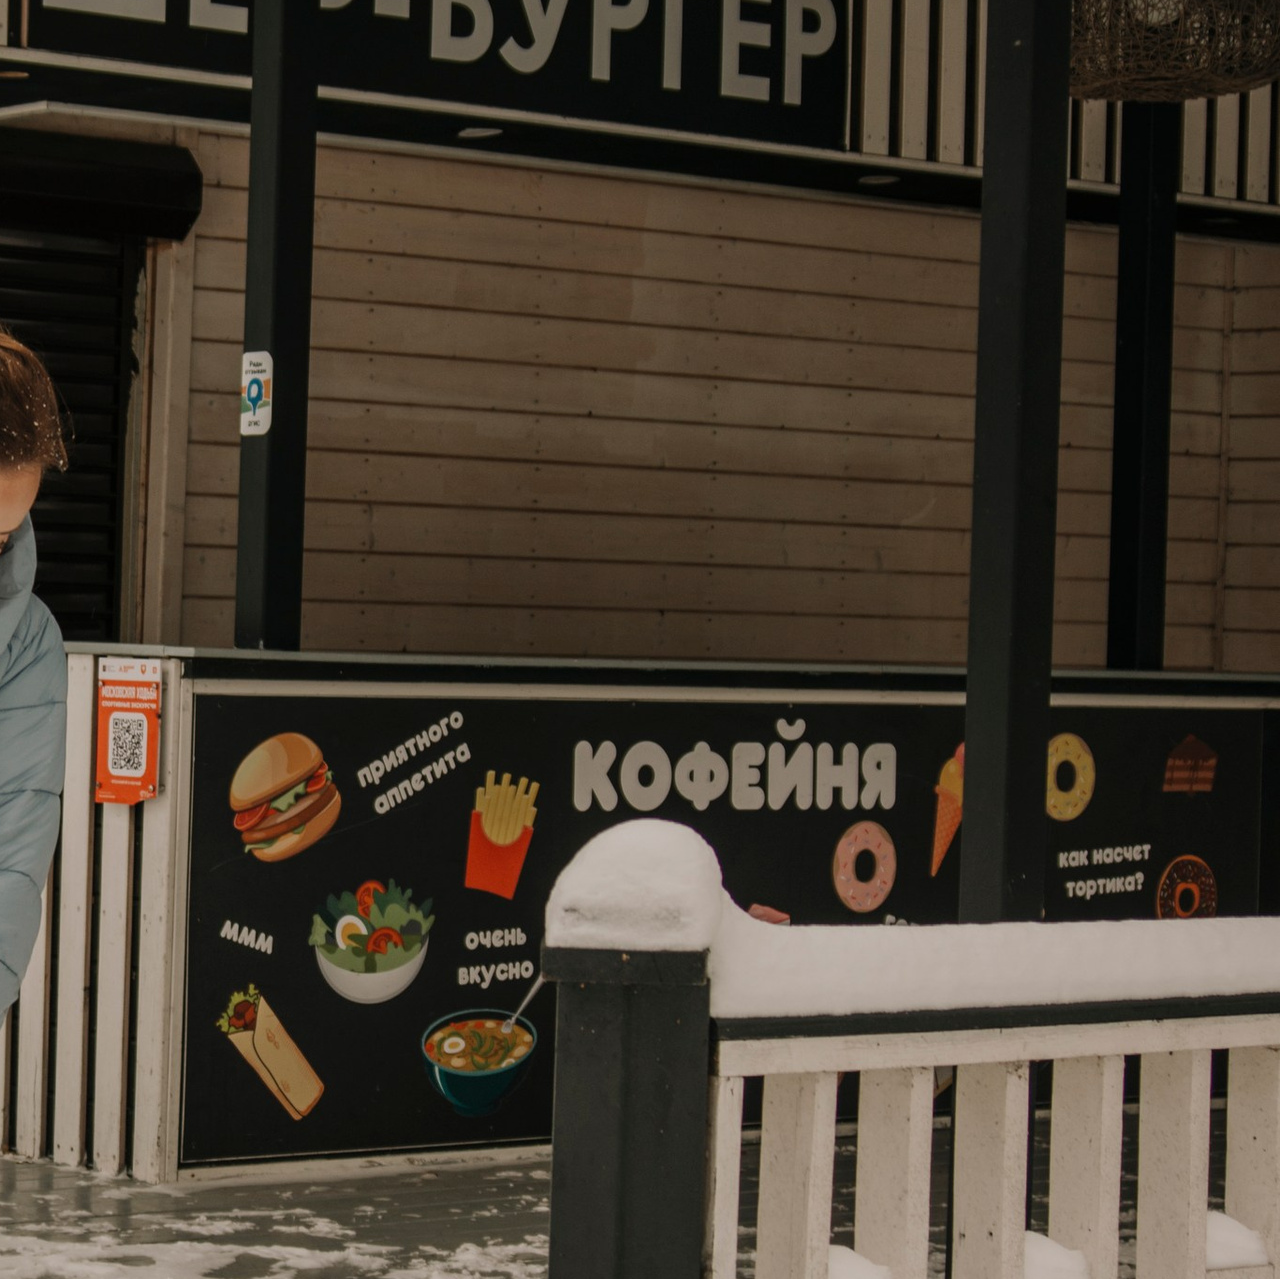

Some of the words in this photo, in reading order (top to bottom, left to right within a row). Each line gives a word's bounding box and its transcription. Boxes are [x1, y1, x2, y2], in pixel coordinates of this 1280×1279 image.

[357, 710, 464, 788] приятного
[374, 742, 471, 814] аппетита
[573, 718, 897, 812] КОФЕЙНЯ
[1058, 849, 1089, 869] как
[1092, 843, 1151, 865] насчет
[1065, 871, 1145, 900] тортика?
[465, 927, 527, 950] очень
[458, 960, 534, 989] вкусно
